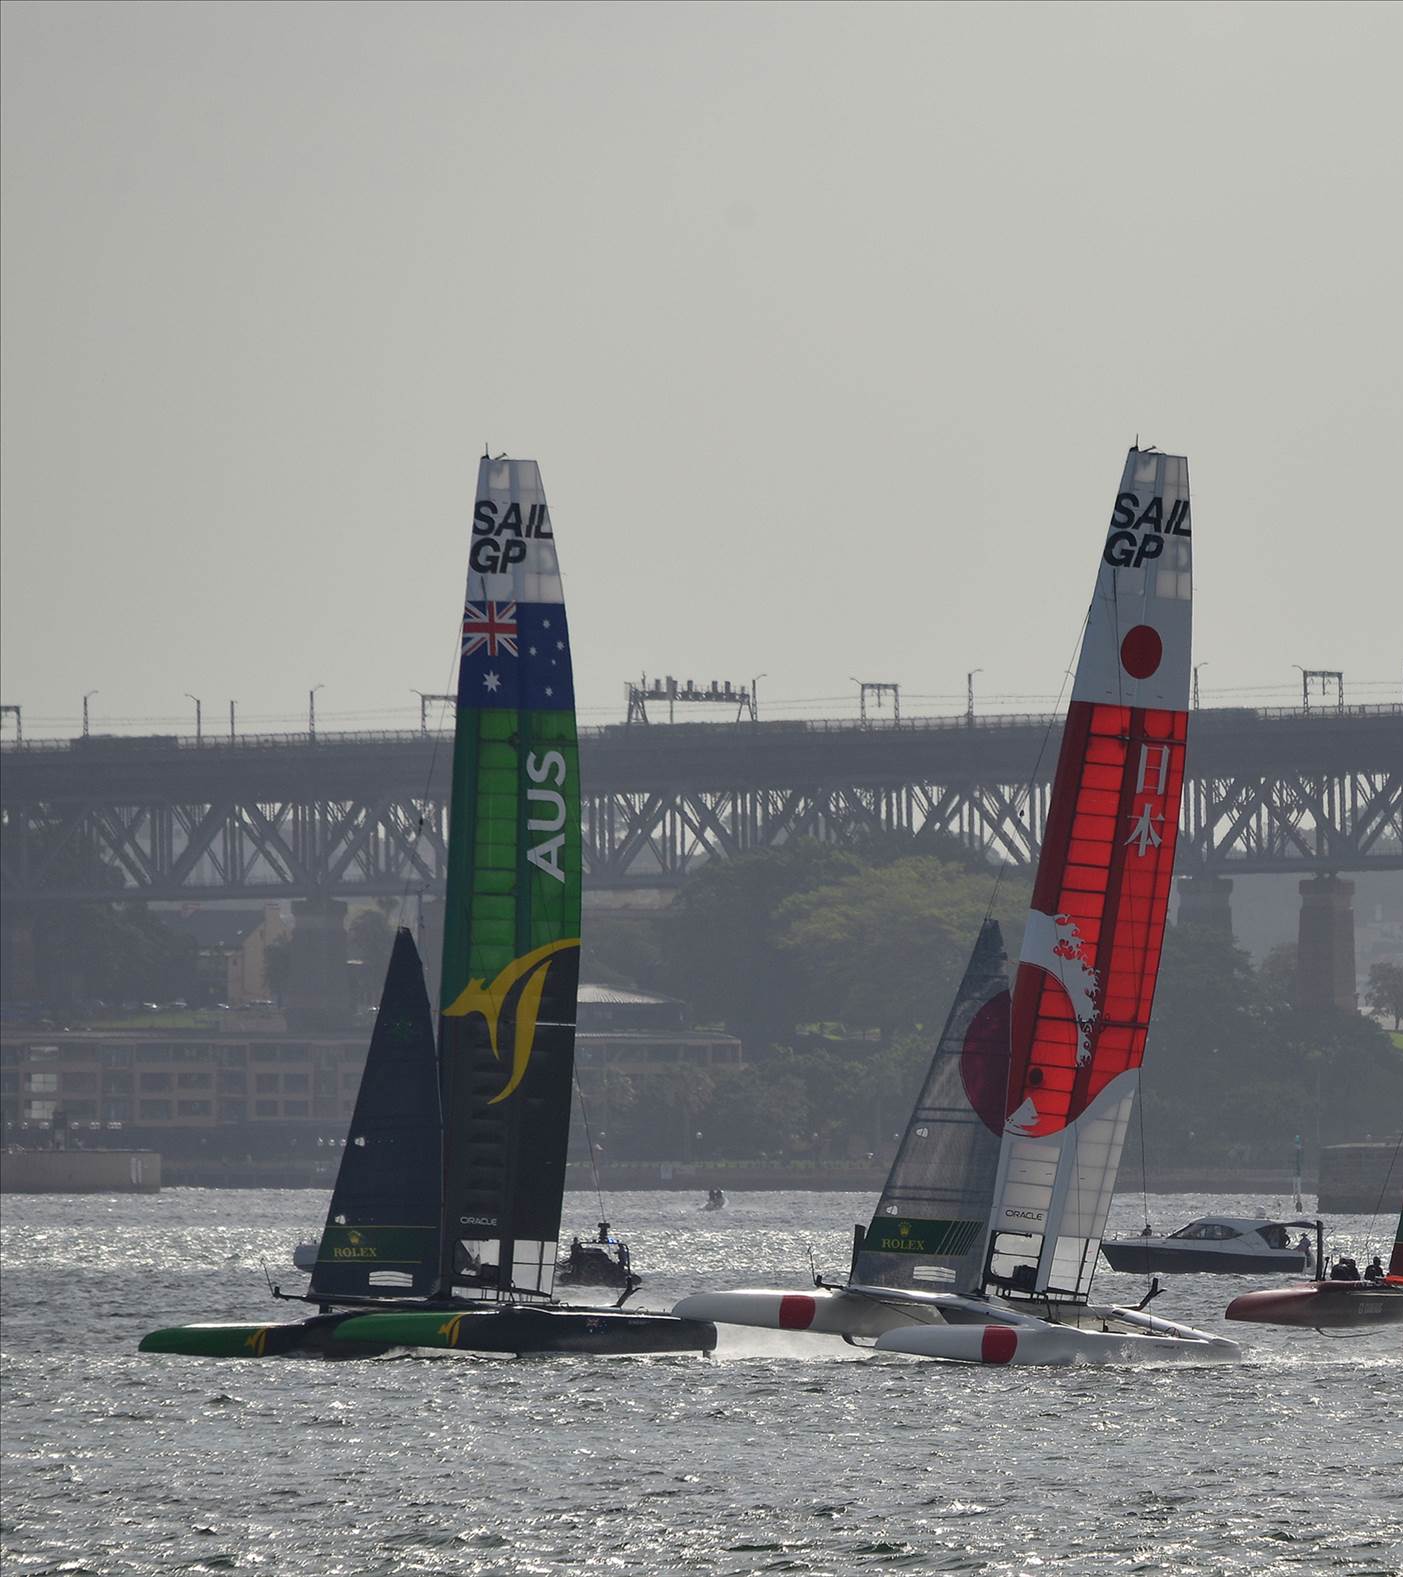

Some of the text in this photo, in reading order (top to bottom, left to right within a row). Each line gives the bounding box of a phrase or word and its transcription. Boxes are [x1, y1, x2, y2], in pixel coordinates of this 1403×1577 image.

[472, 500, 553, 539] SAIL
[1110, 493, 1192, 537] SAIL
[469, 537, 527, 574] GP
[1103, 531, 1164, 568] GP
[526, 751, 566, 884] AUS
[1123, 743, 1170, 857] 日本
[460, 1215, 497, 1226] ORACLE
[1005, 1209, 1043, 1221] ORACLE
[334, 1247, 377, 1257] ROLEX
[882, 1238, 925, 1250] ROLEX
